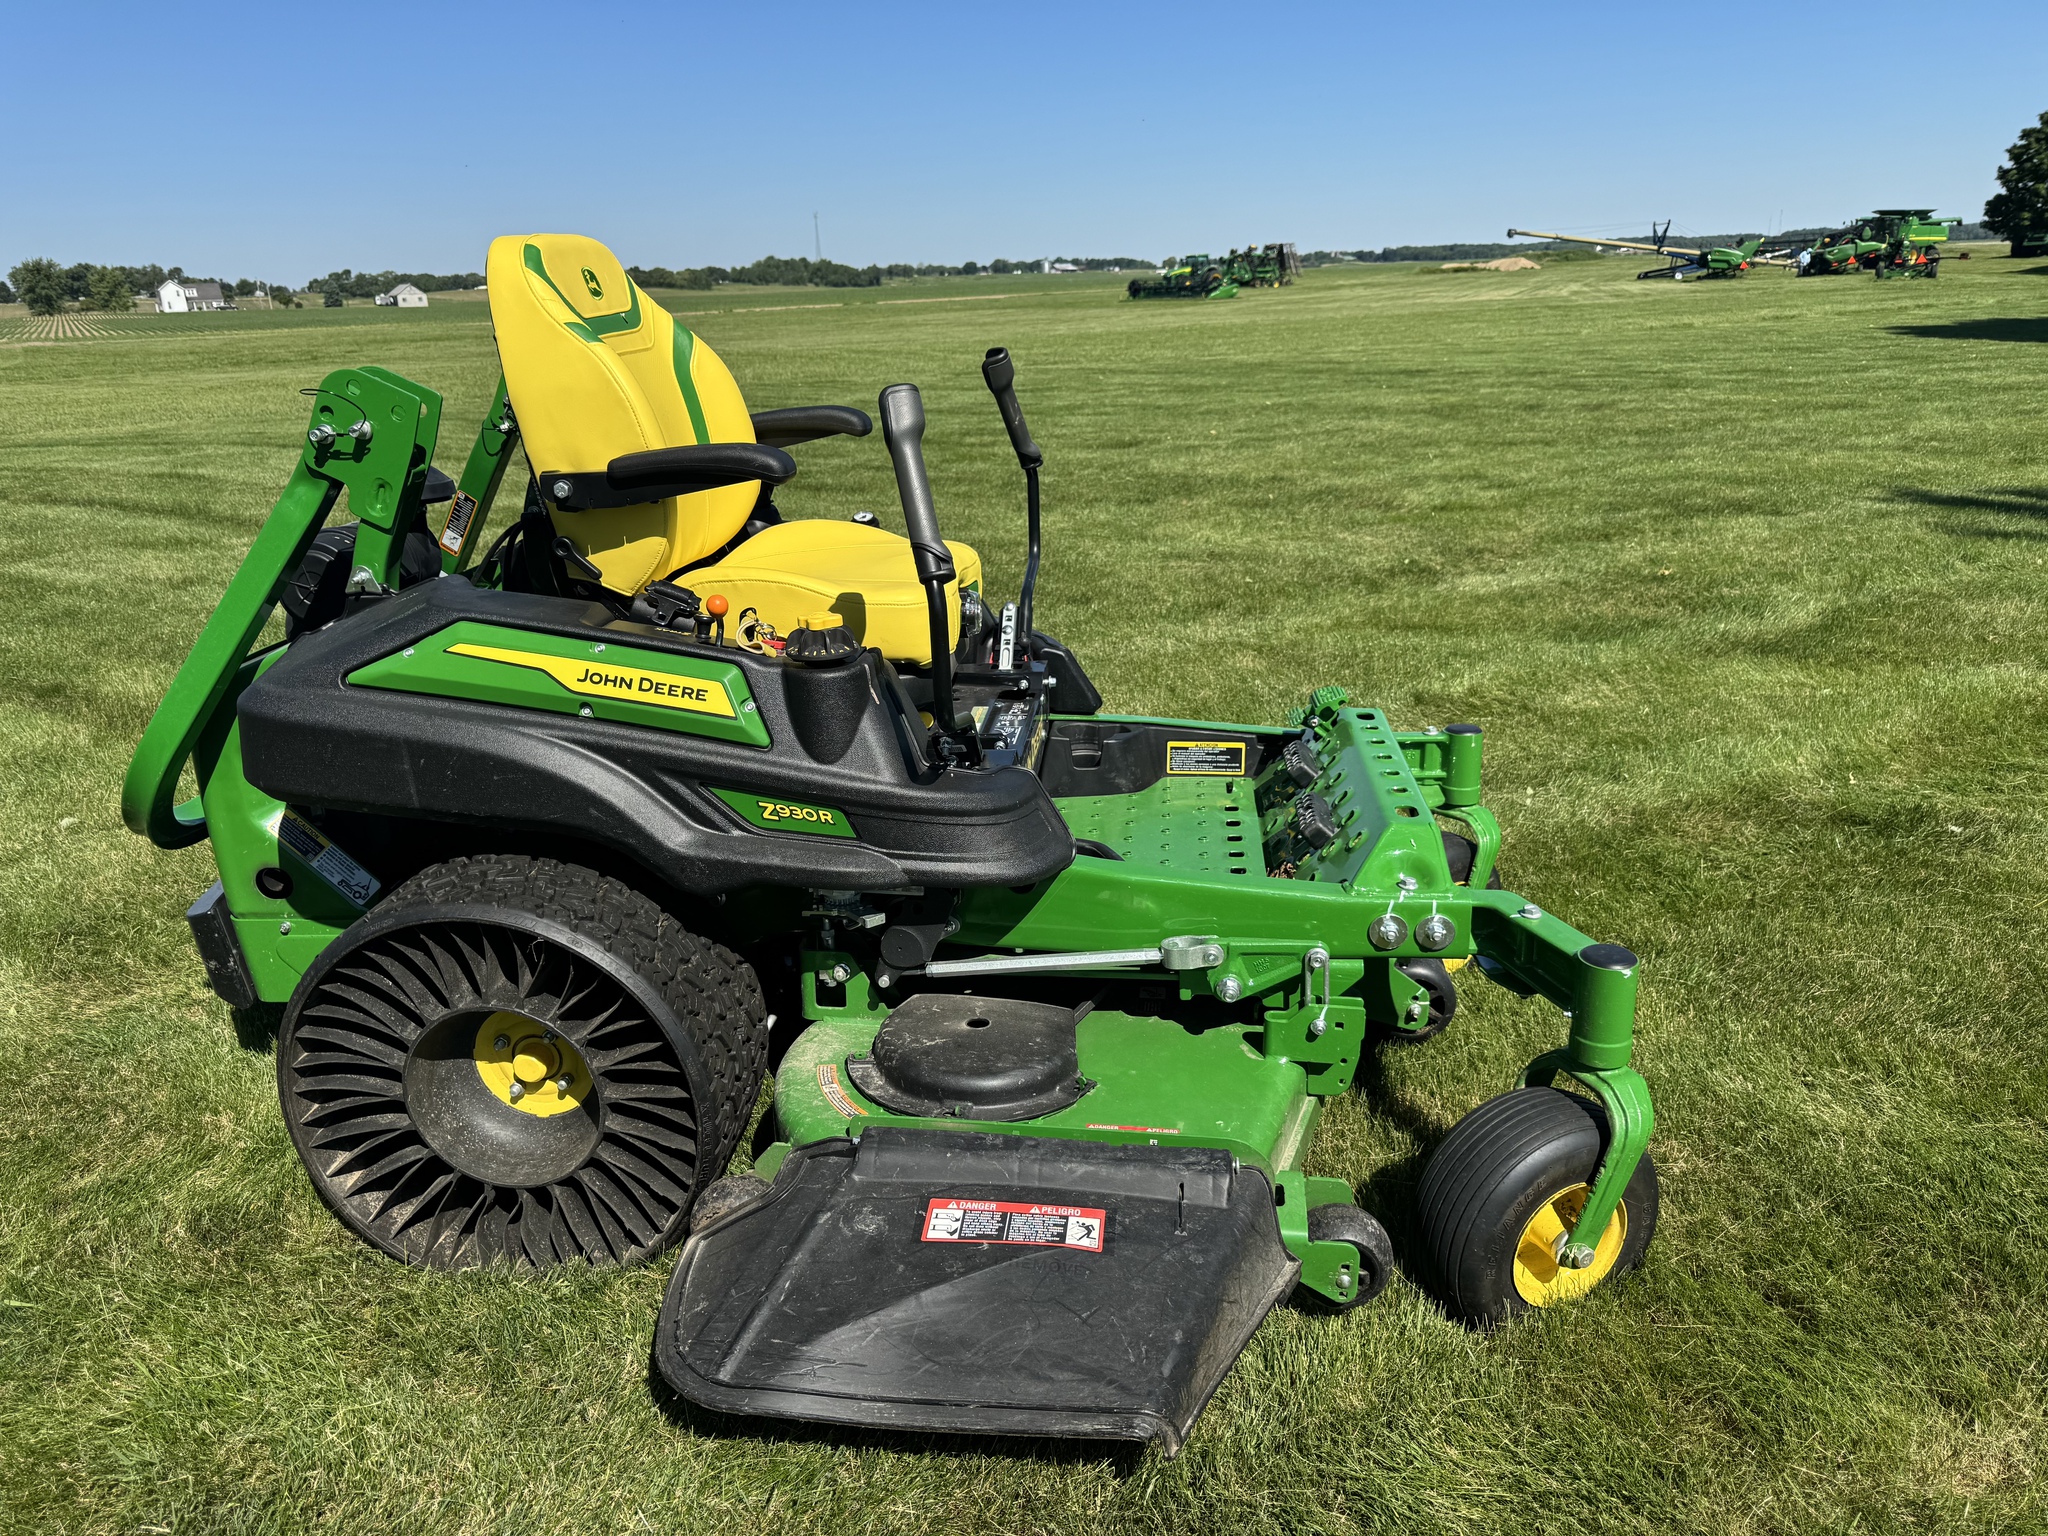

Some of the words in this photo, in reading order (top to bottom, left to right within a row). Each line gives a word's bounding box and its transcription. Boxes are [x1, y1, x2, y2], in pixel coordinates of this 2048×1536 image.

[577, 668, 633, 690] JOHN
[638, 677, 709, 702] DEERE
[757, 801, 836, 825] Z930R
[298, 820, 320, 840] CAUTION
[959, 1201, 996, 1211] DANGER
[1041, 1206, 1081, 1217] PELIGRO
